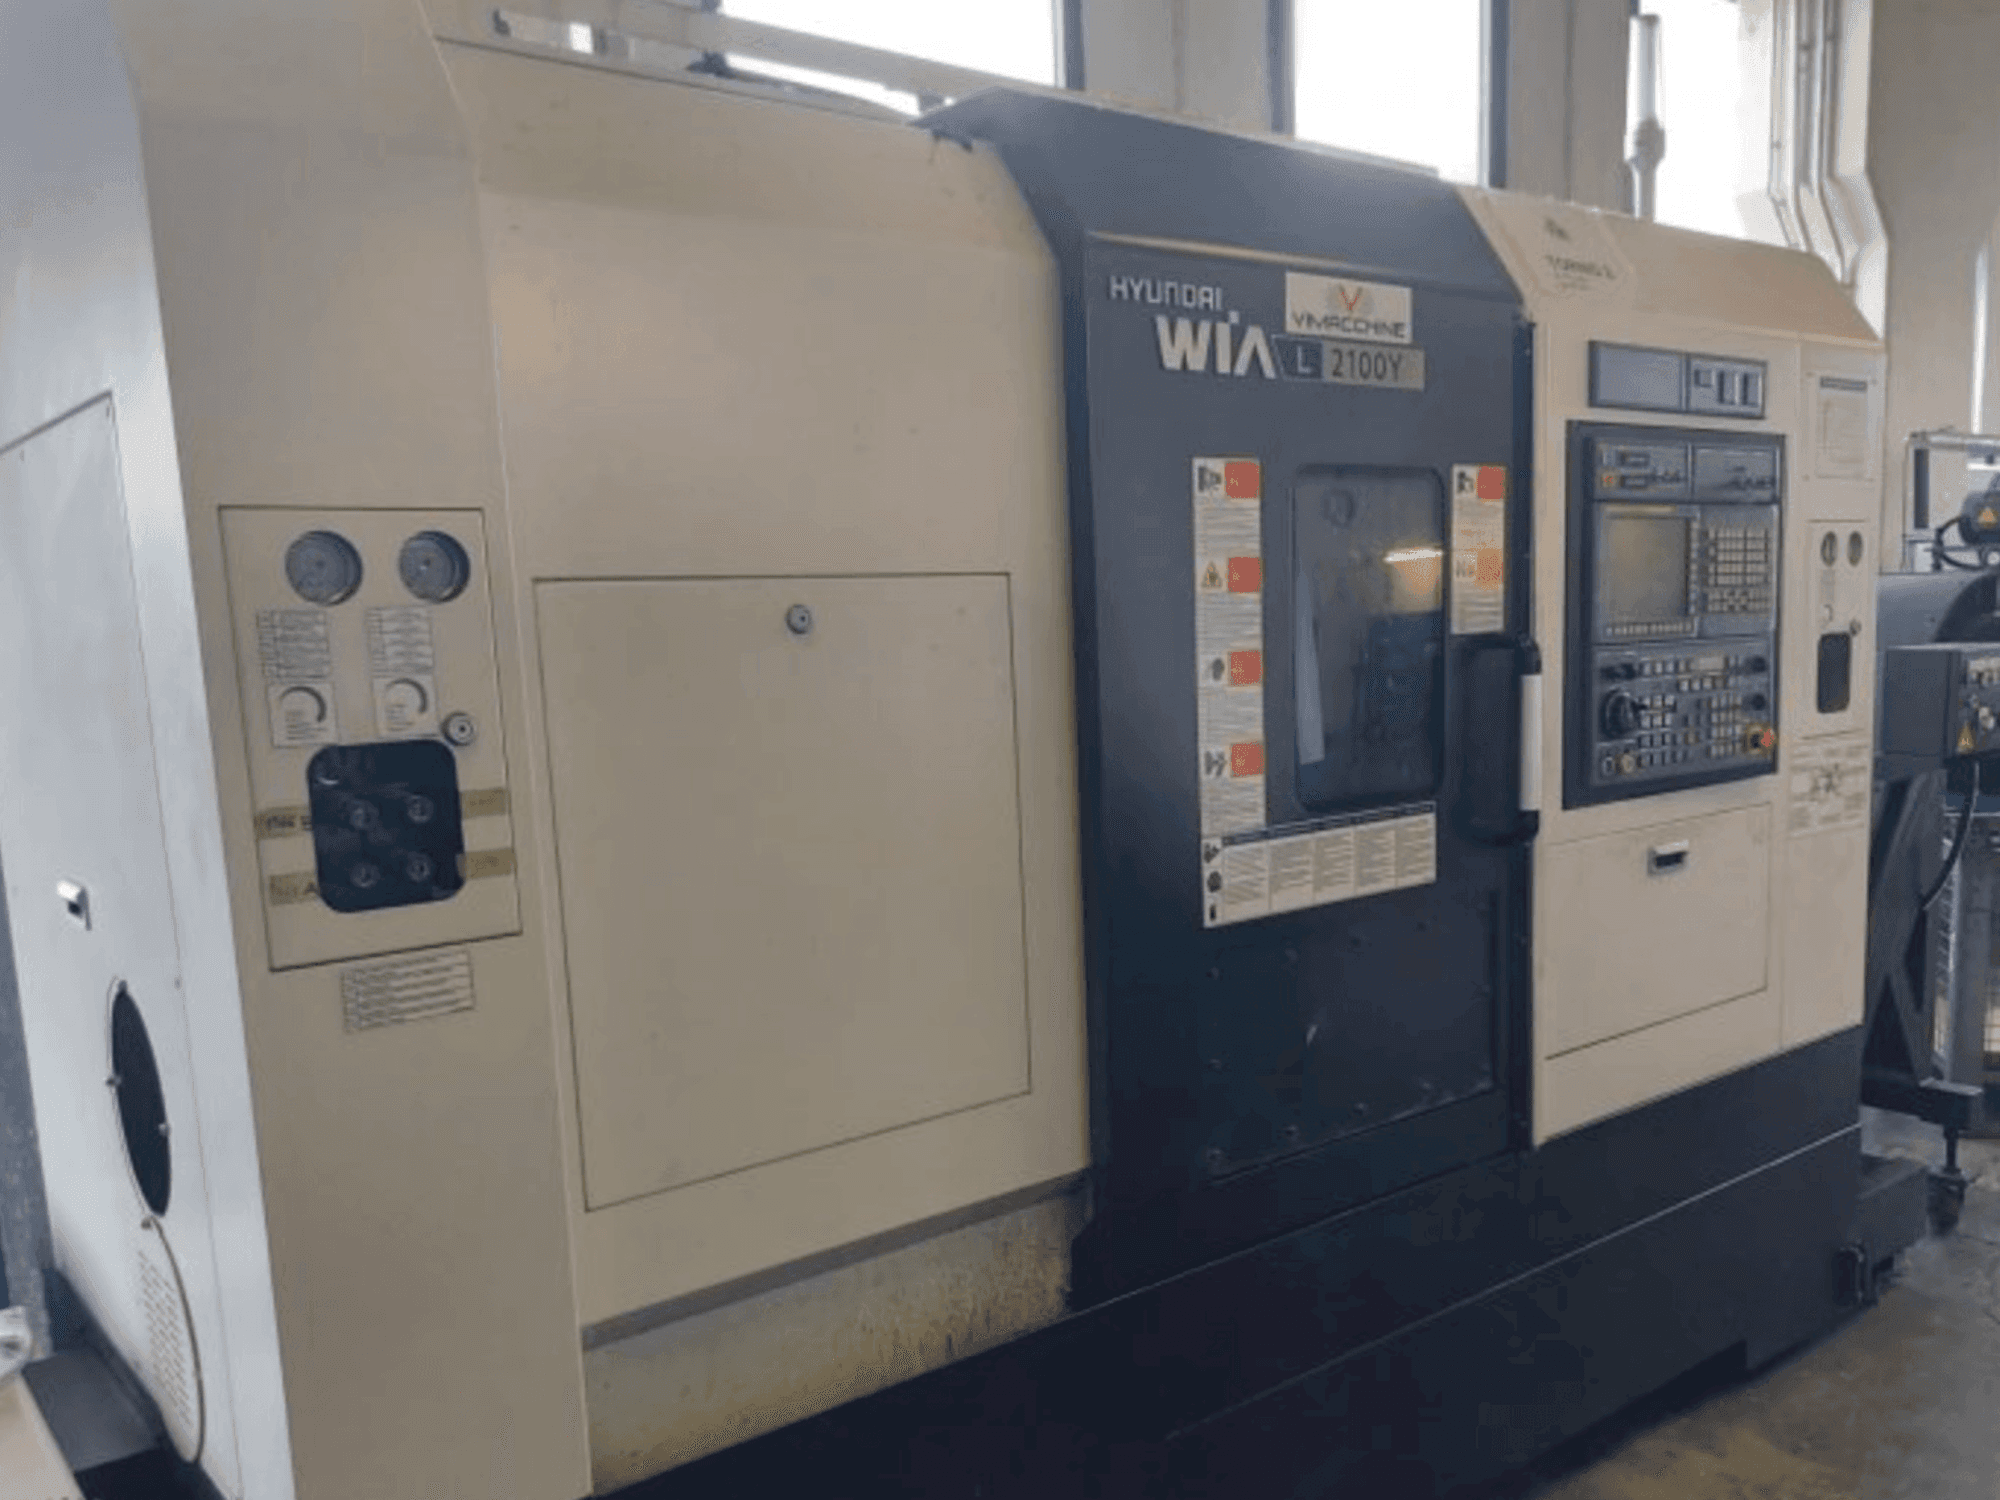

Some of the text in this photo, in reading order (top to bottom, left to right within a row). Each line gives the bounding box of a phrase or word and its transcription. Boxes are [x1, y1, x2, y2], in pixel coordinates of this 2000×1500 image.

[1110, 276, 1223, 310] HYUNDAI
[1292, 313, 1406, 338] VIMACCHINE
[1331, 347, 1403, 382] 2100Y
